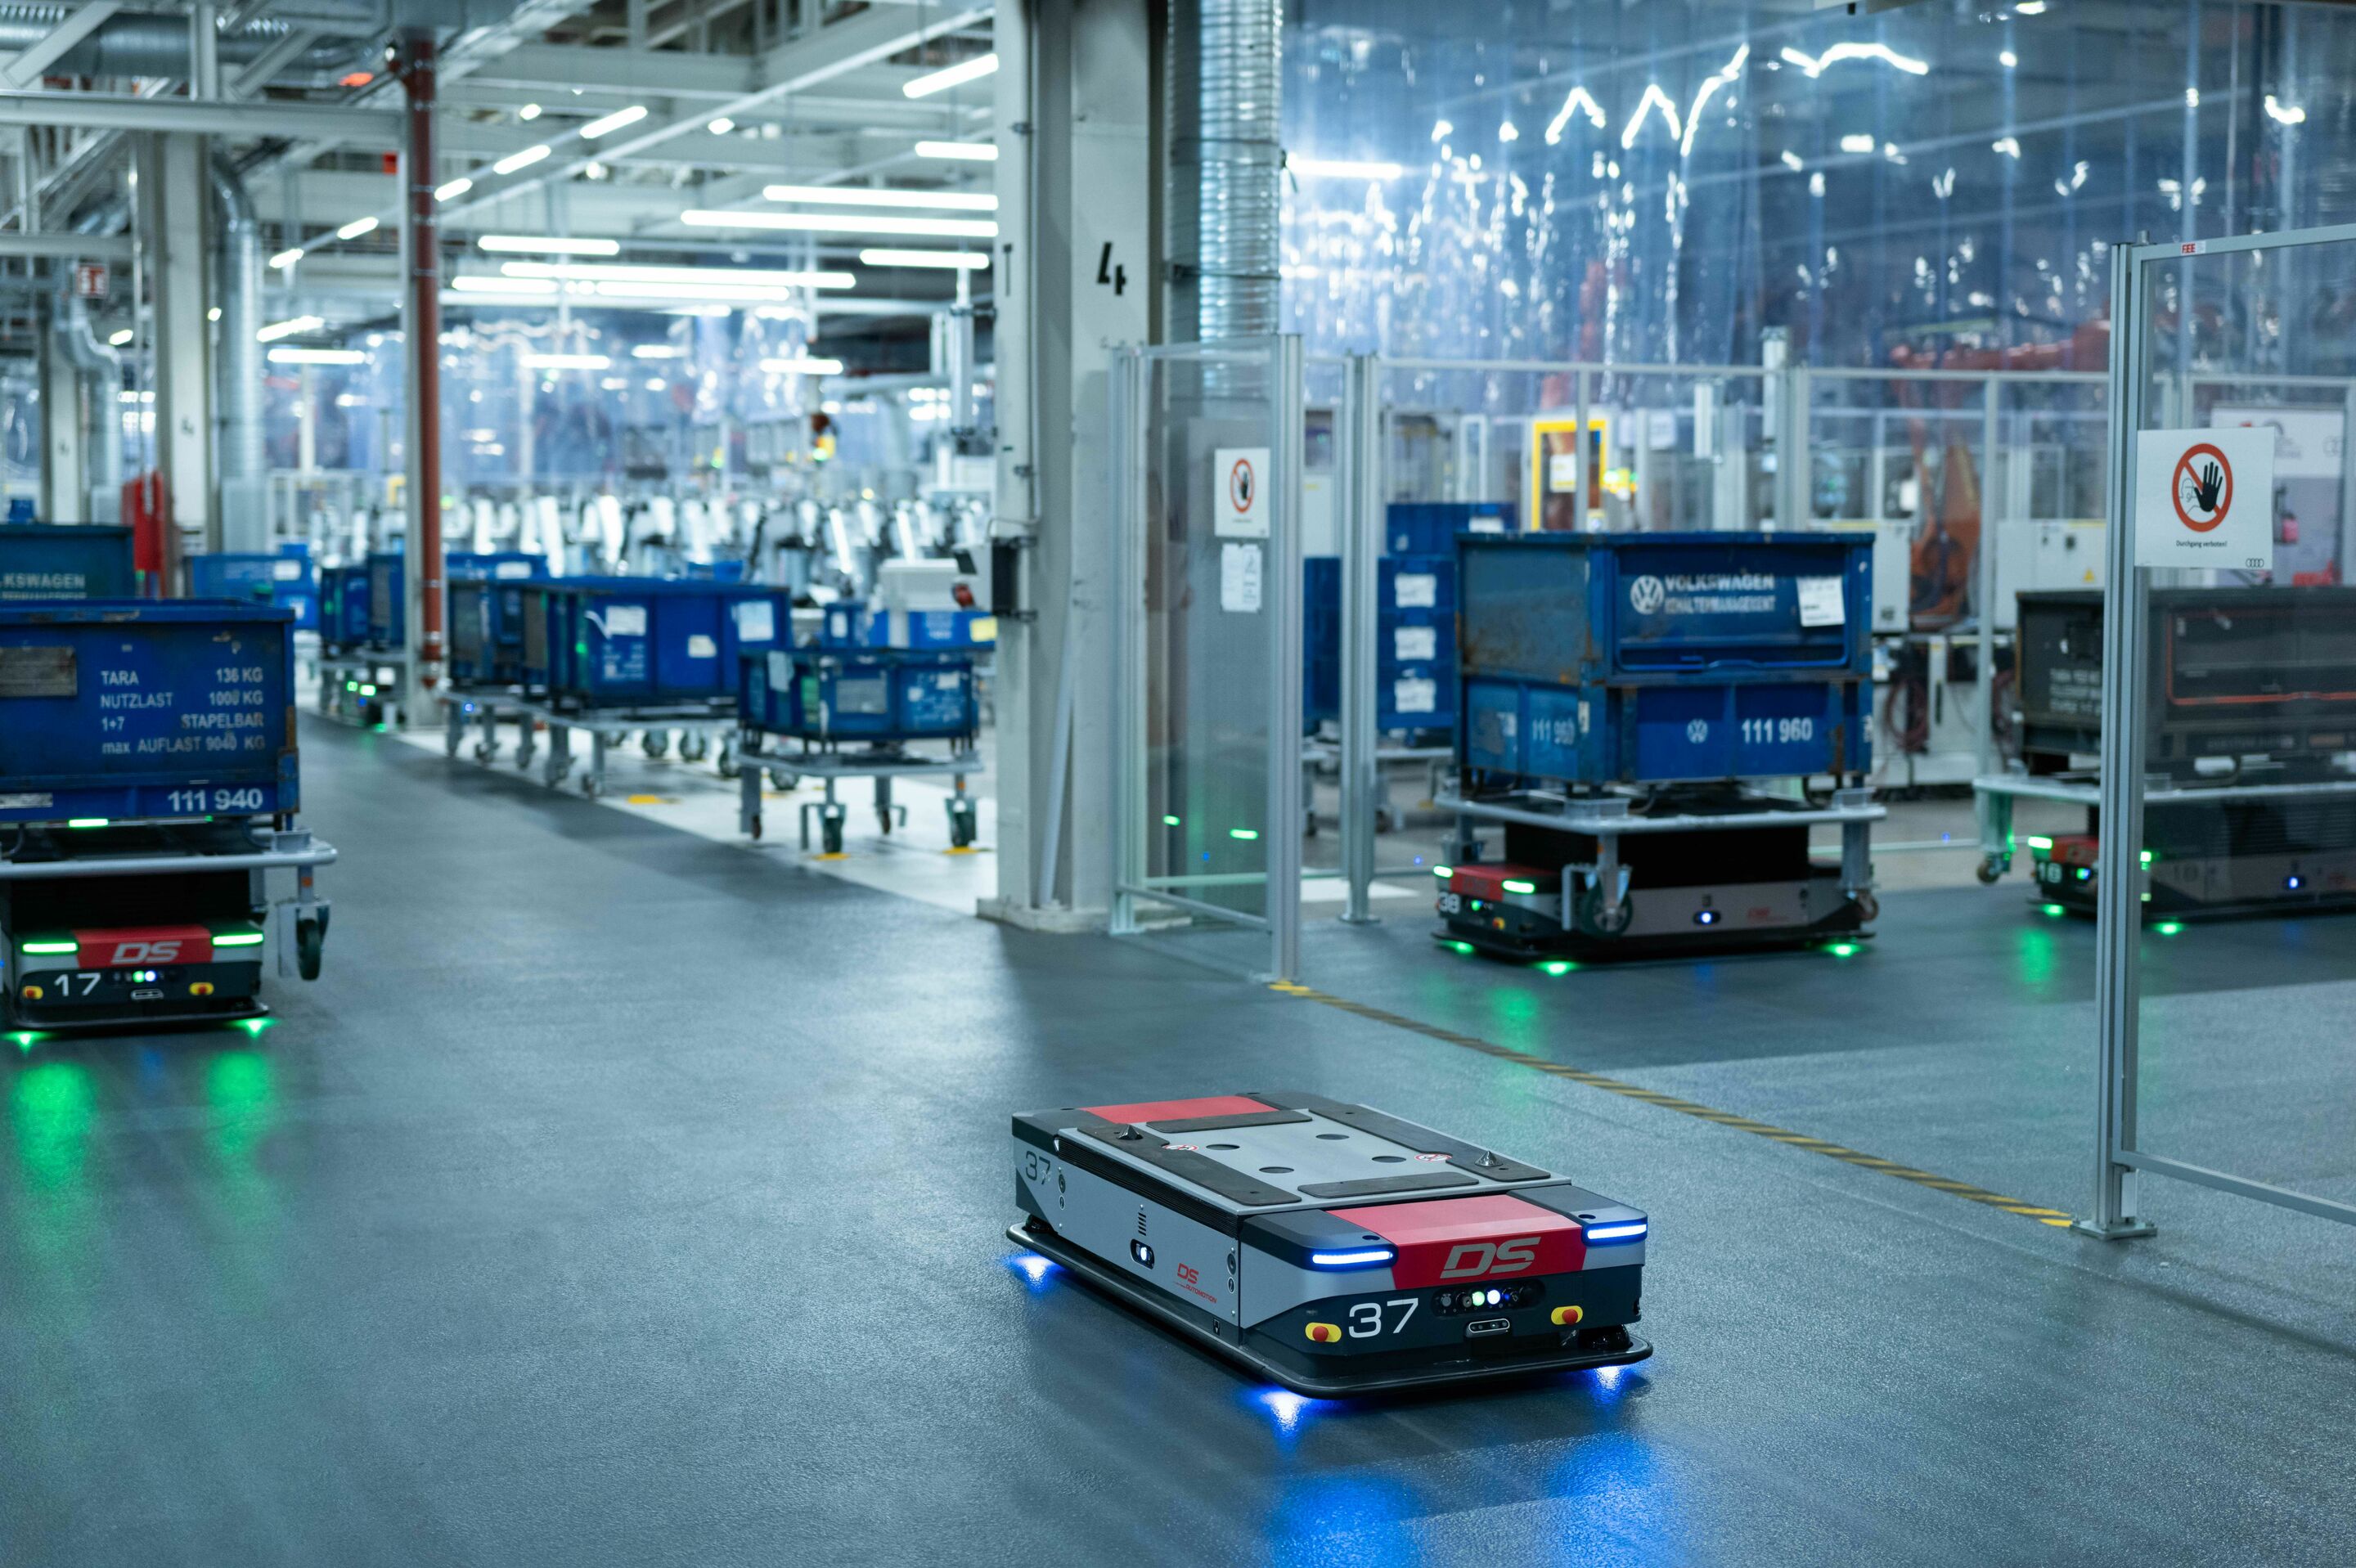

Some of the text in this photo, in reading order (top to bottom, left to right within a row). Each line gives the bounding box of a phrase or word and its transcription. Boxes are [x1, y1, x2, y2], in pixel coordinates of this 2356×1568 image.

[1098, 241, 1126, 295] 4
[2176, 540, 2228, 549] Durchgang verboten!
[0, 573, 85, 588] KSWAGEN
[1665, 574, 1775, 591] VOLKSWAGEN
[101, 667, 263, 685] TARA 136 KG
[100, 692, 173, 709] NUTZLAST
[243, 690, 263, 705] KG
[181, 712, 263, 729] STAPELBAR
[1742, 718, 1813, 744] 111 960
[101, 741, 130, 754] max
[137, 736, 201, 753] AUFLAST
[244, 735, 265, 750] KG
[168, 788, 263, 811] 111 940
[111, 941, 182, 964] DS
[54, 973, 101, 996] 17
[1026, 1150, 1050, 1185] 37
[1440, 1237, 1541, 1279] DS
[1177, 1263, 1199, 1284] DS
[1185, 1284, 1217, 1304] AUTOMOTION
[1348, 1297, 1419, 1339] 37
